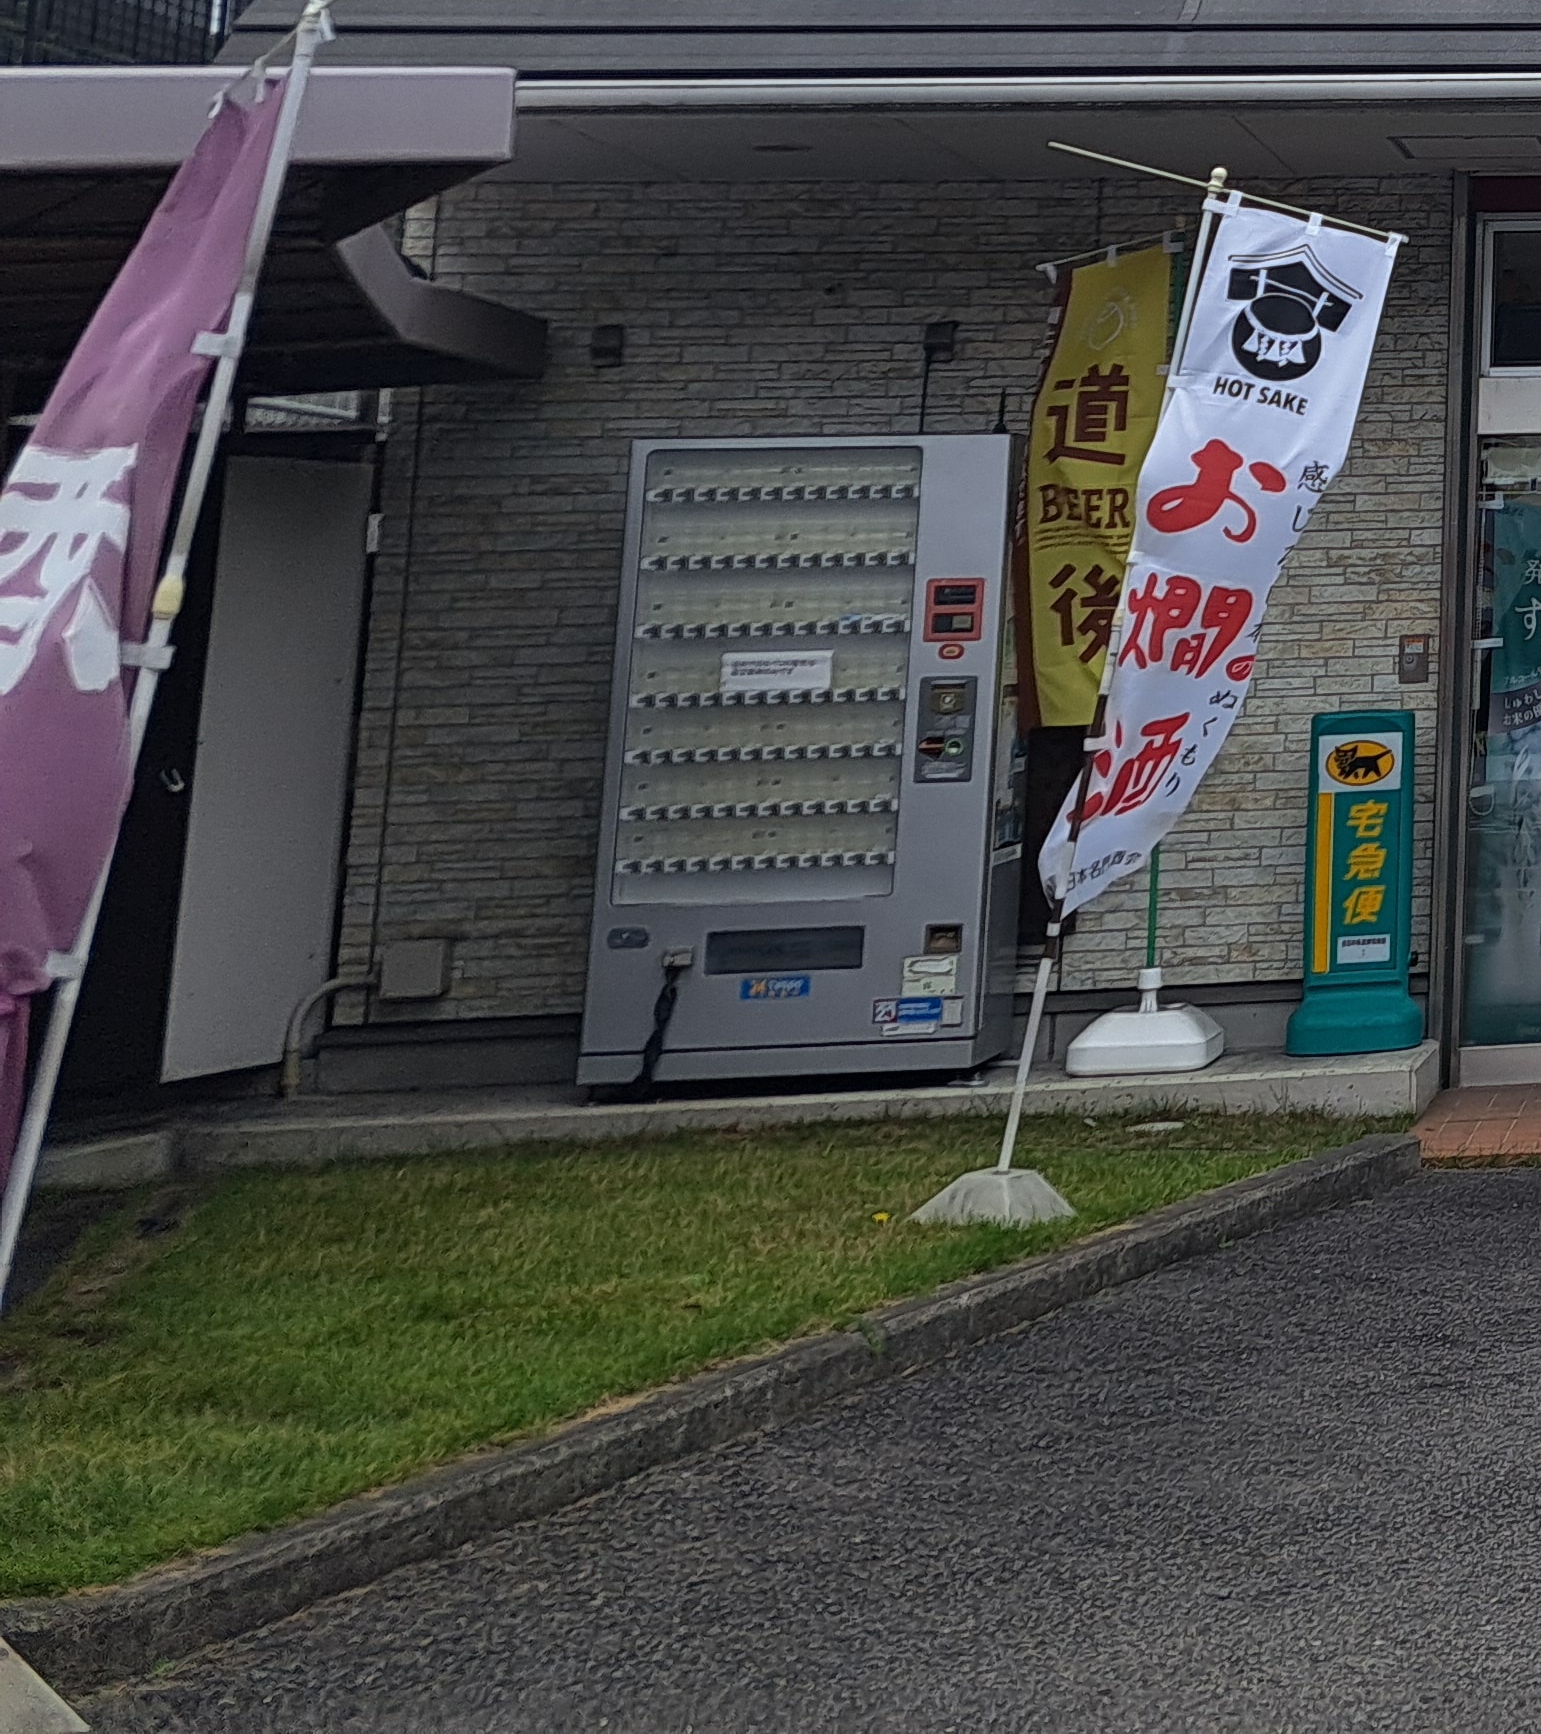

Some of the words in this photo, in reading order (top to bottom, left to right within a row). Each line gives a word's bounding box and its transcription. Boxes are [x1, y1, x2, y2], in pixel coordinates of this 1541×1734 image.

[1043, 363, 1131, 466] 道
[1213, 376, 1256, 403] HOT
[1257, 384, 1309, 417] SAKE
[1038, 483, 1132, 531] BEER
[1343, 799, 1388, 925] 宅急便
